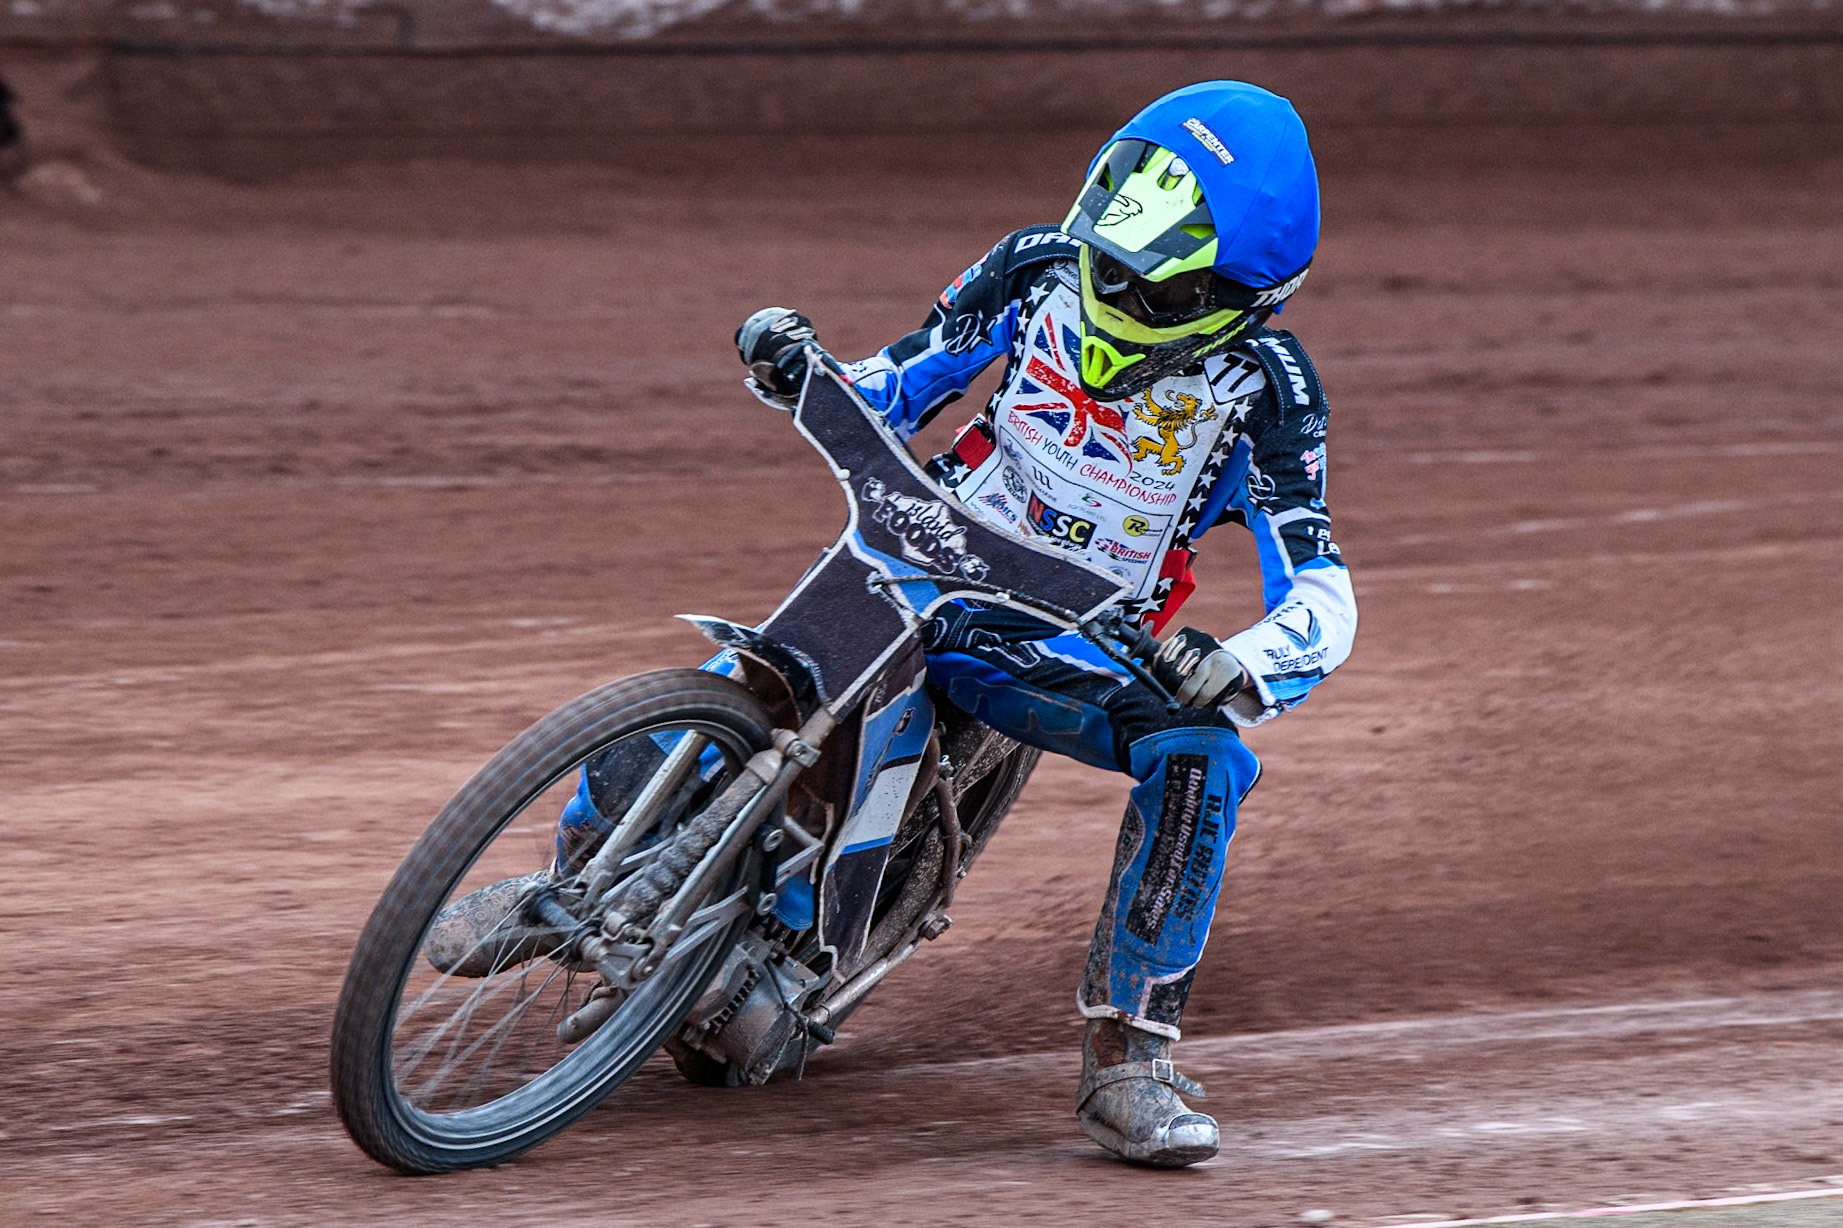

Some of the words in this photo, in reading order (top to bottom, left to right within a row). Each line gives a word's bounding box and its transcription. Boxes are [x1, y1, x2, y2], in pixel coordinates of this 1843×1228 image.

[1210, 352, 1261, 394] 77
[1257, 337, 1310, 405] MUM
[1008, 410, 1043, 445] BRITISH
[1042, 437, 1079, 471] YOUTH
[1079, 463, 1177, 507] CHAMPIONSHIP
[1129, 470, 1176, 491] 2024
[872, 500, 963, 573] FOODS
[1029, 495, 1091, 543] NSSC
[1110, 540, 1152, 560] BRITISH
[1181, 768, 1205, 824] Quality
[1173, 822, 1193, 861] Used
[1145, 884, 1172, 930] Sales
